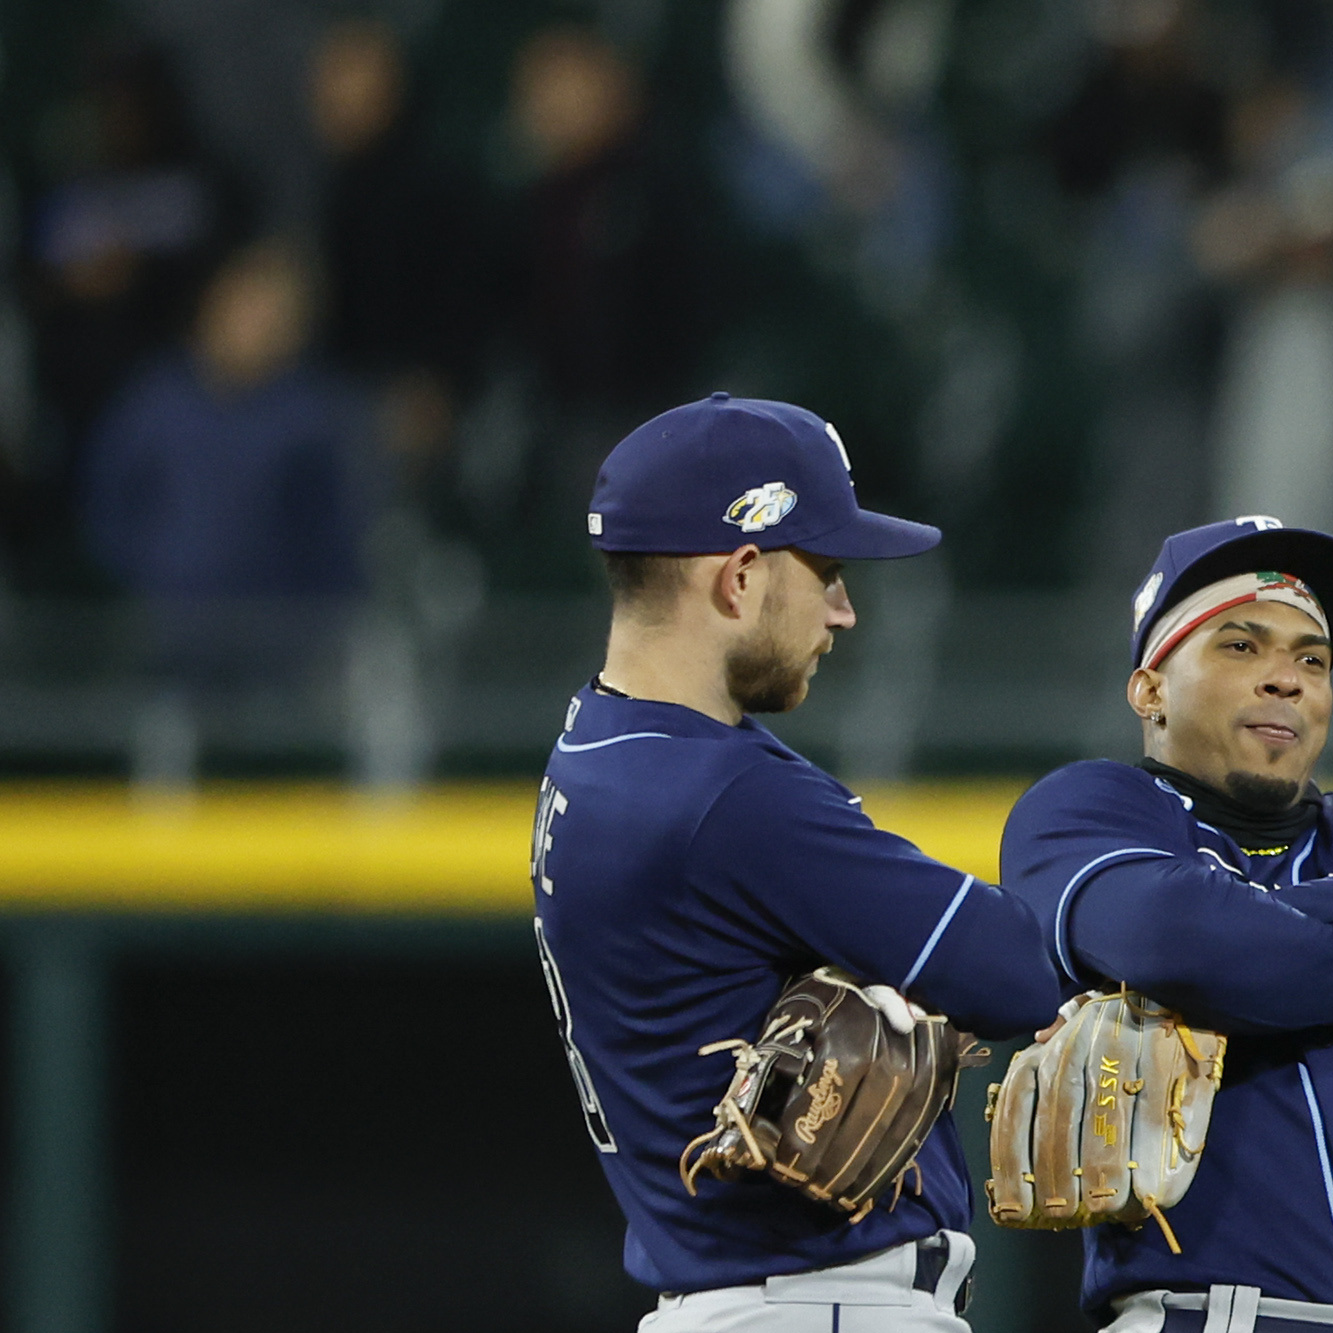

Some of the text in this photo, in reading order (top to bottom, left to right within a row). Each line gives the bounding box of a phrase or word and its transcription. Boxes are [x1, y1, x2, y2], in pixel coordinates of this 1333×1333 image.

[741, 481, 786, 533] 25
[795, 1058, 843, 1144] Rawlings
[1099, 1055, 1120, 1110] SSK
